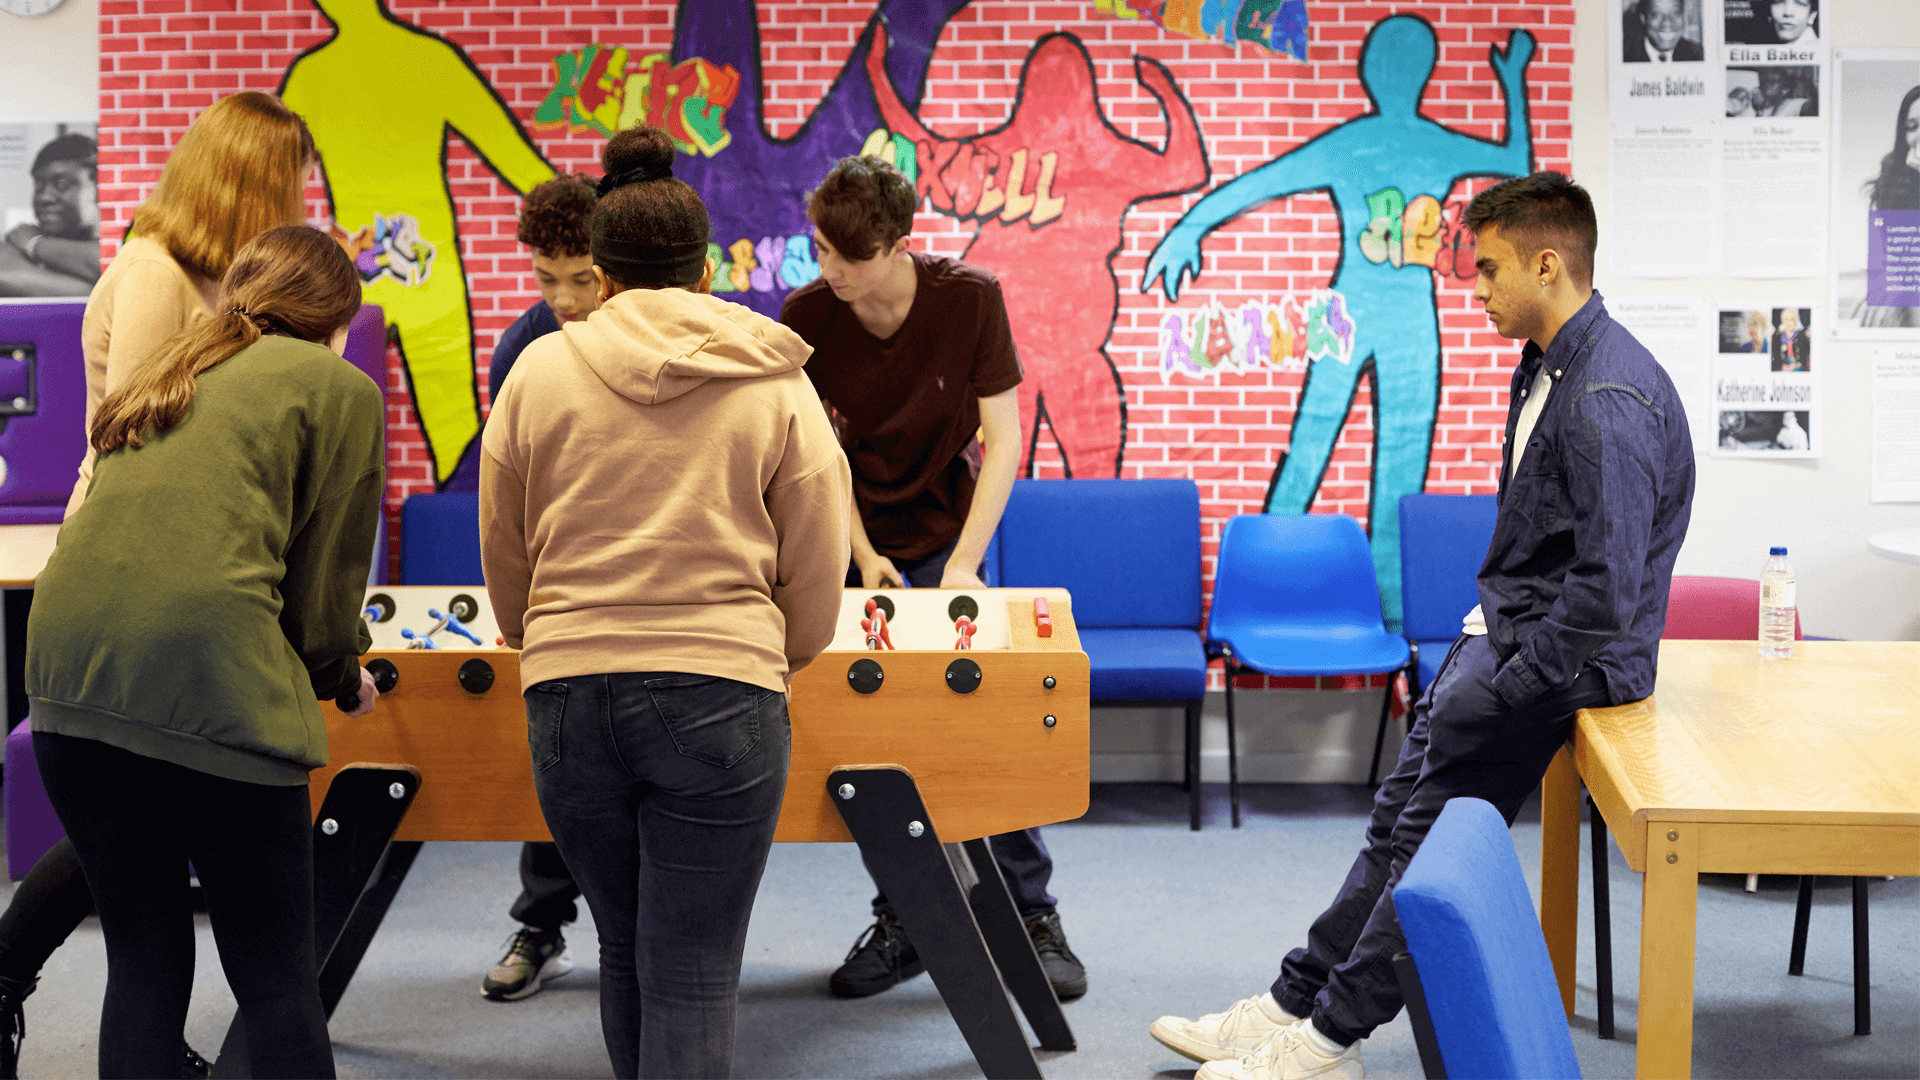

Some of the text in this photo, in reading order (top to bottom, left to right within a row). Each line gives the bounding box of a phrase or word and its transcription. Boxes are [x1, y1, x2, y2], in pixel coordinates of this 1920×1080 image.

[1730, 48, 1815, 61] Ella Baker
[1630, 75, 1705, 97] James Baldwin
[1717, 378, 1812, 402] Katherine Johnson
